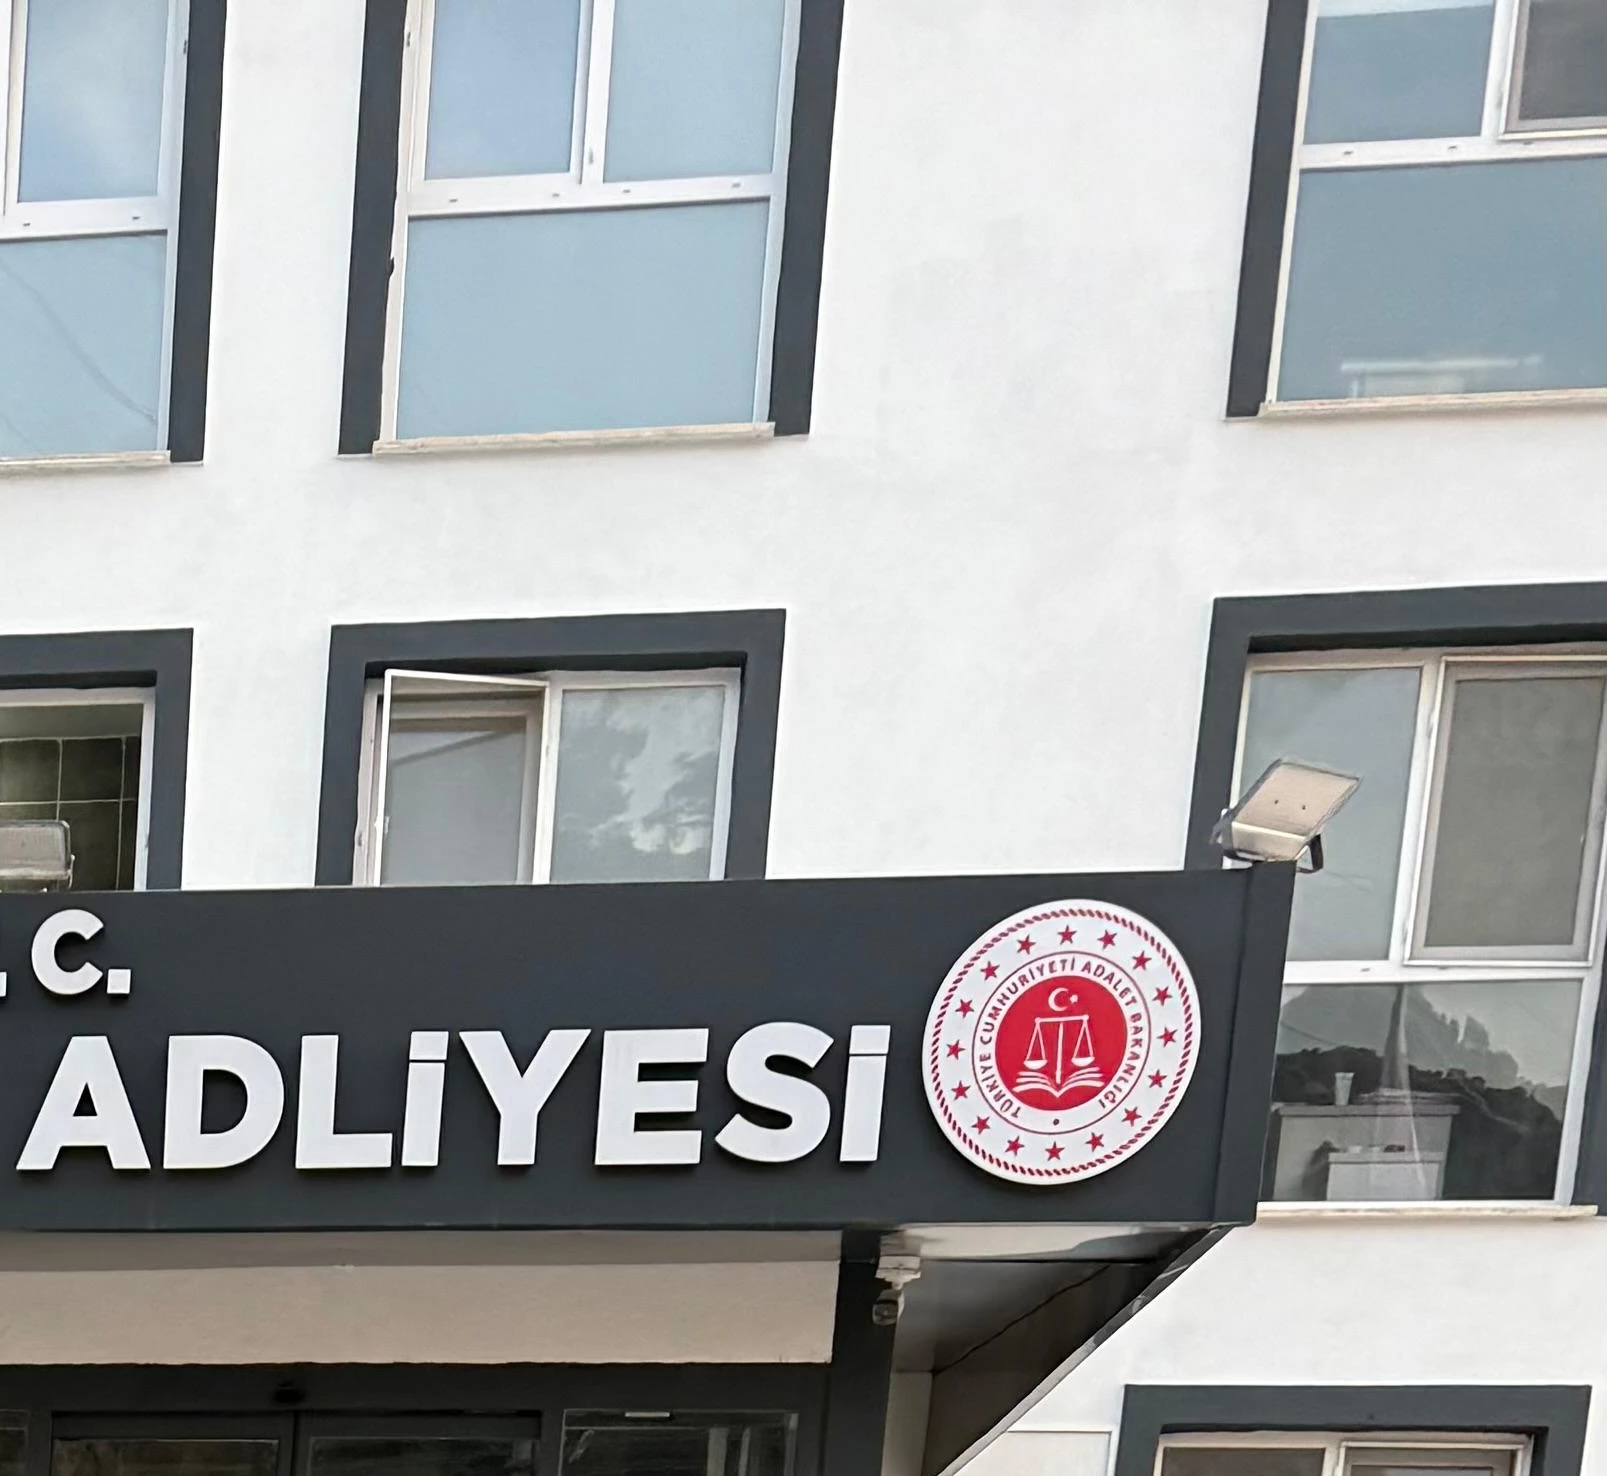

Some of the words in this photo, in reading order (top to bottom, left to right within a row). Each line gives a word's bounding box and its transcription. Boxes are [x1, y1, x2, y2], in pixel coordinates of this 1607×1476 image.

[31, 908, 132, 995] C.
[1080, 960, 1137, 1007] ADALET
[981, 956, 1076, 1045] CUMHURİYETİ
[15, 1020, 891, 1171] ADLİYESİ
[1098, 1012, 1144, 1110] BAKANLIĞI
